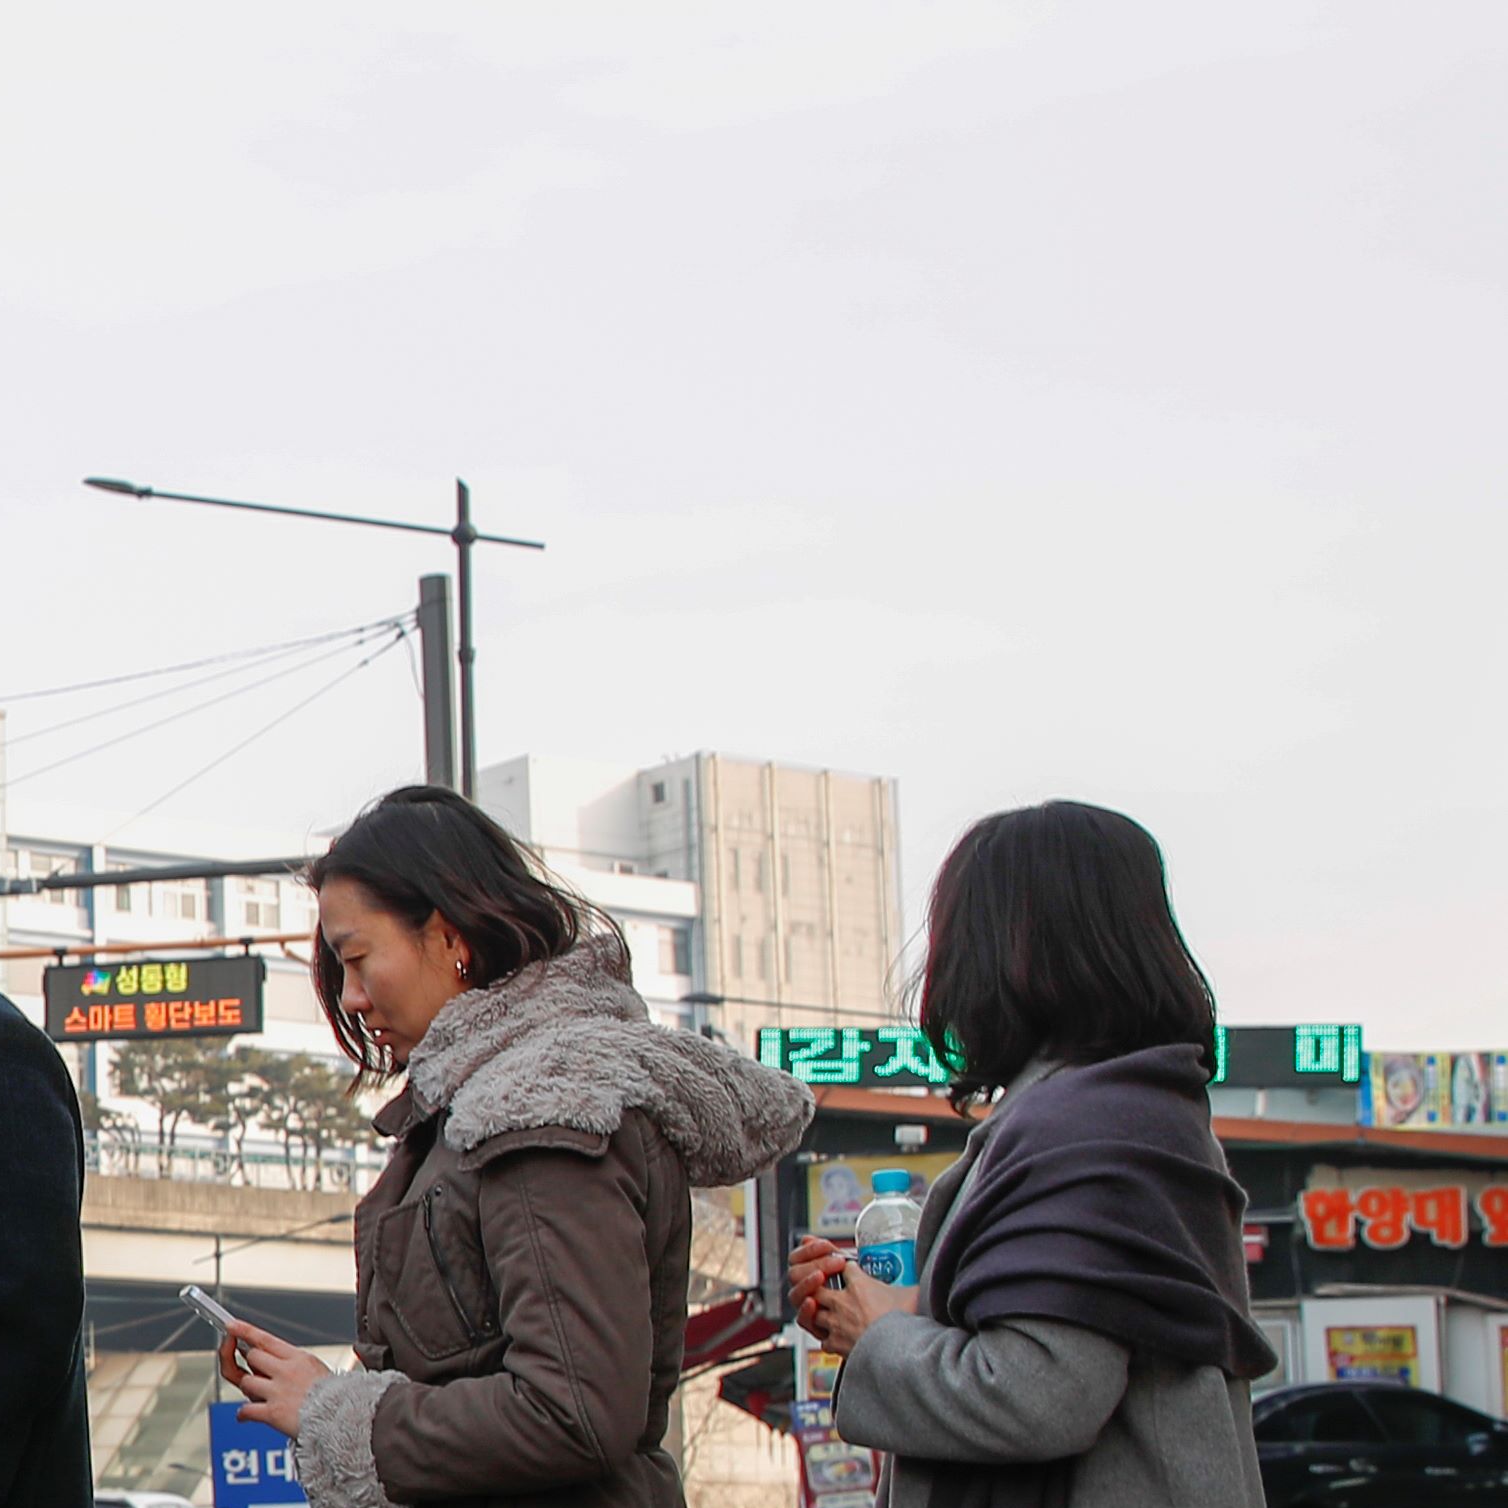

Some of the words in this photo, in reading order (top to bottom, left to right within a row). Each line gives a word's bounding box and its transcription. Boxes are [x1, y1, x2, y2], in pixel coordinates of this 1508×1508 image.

[116, 962, 188, 996] 성동형
[64, 1003, 136, 1033] 스마트
[144, 998, 243, 1032] 횡단보도
